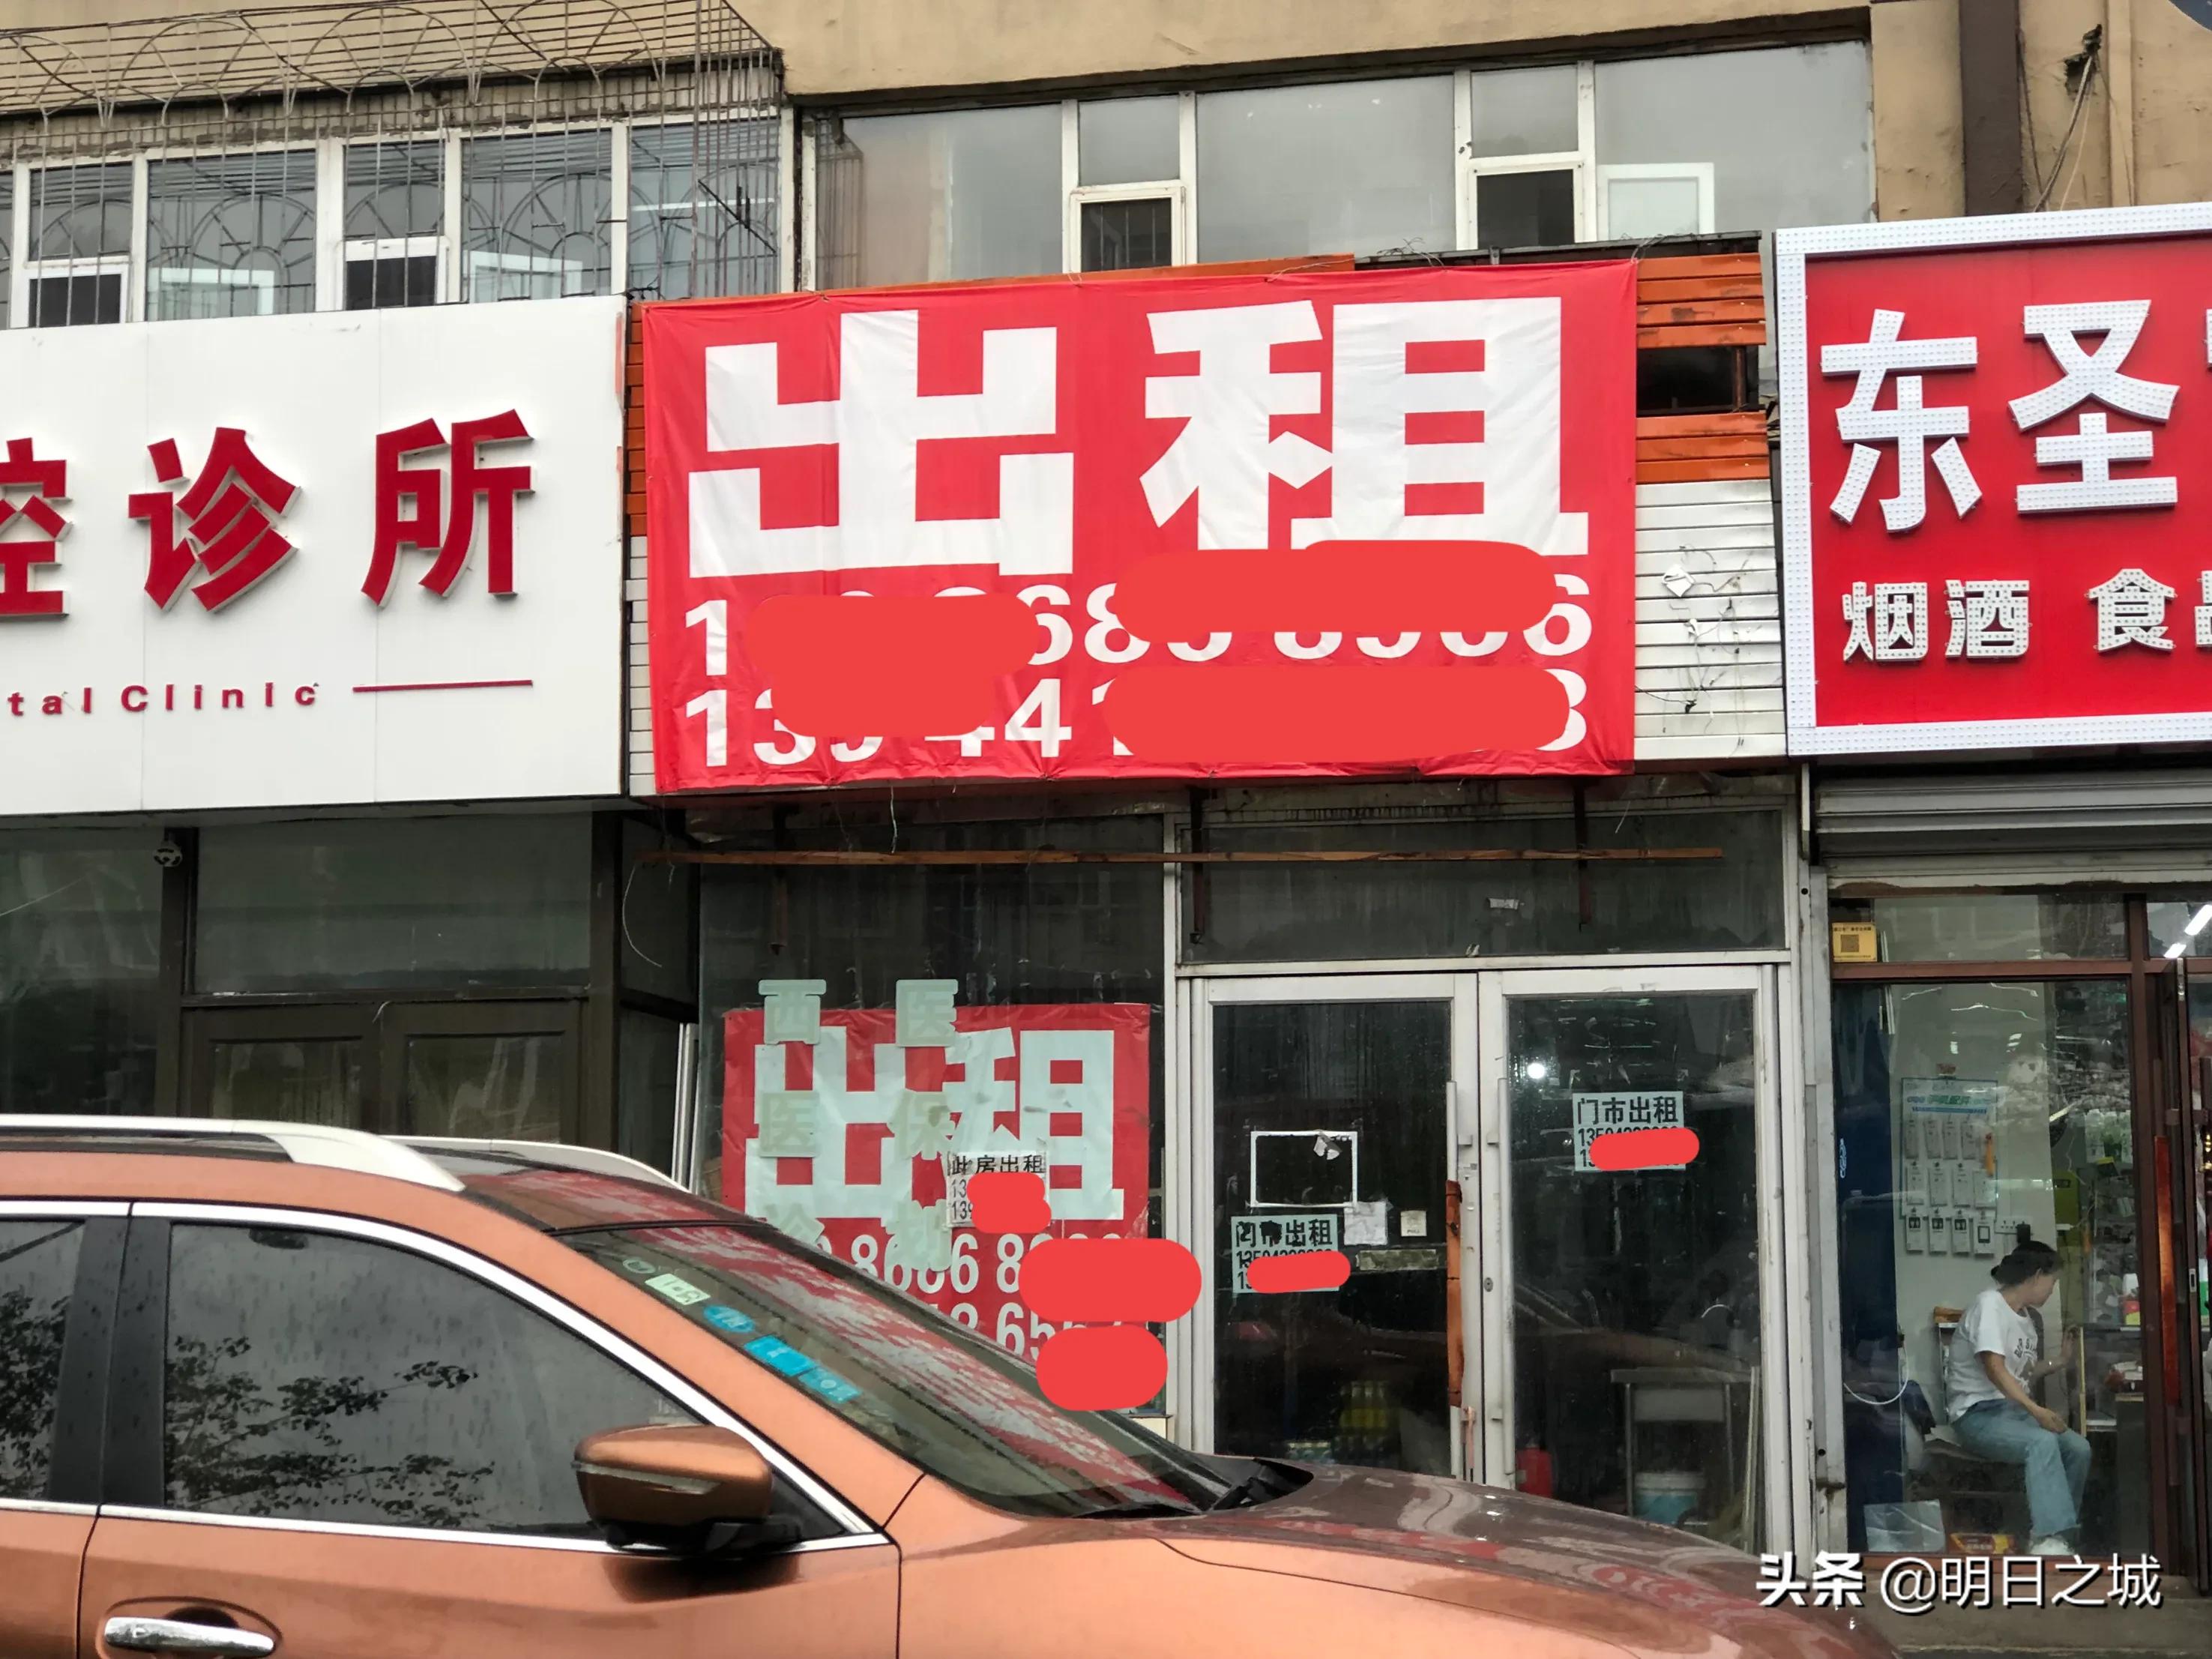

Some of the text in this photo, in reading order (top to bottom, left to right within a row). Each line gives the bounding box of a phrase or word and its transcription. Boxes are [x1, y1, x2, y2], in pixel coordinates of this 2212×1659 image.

[688, 297, 1588, 578] 出租
[1821, 300, 2212, 533] 东圣
[1843, 567, 2212, 661] 烟酒 食
[121, 681, 316, 714] Clinic
[1578, 1096, 1678, 1124] 门市出租
